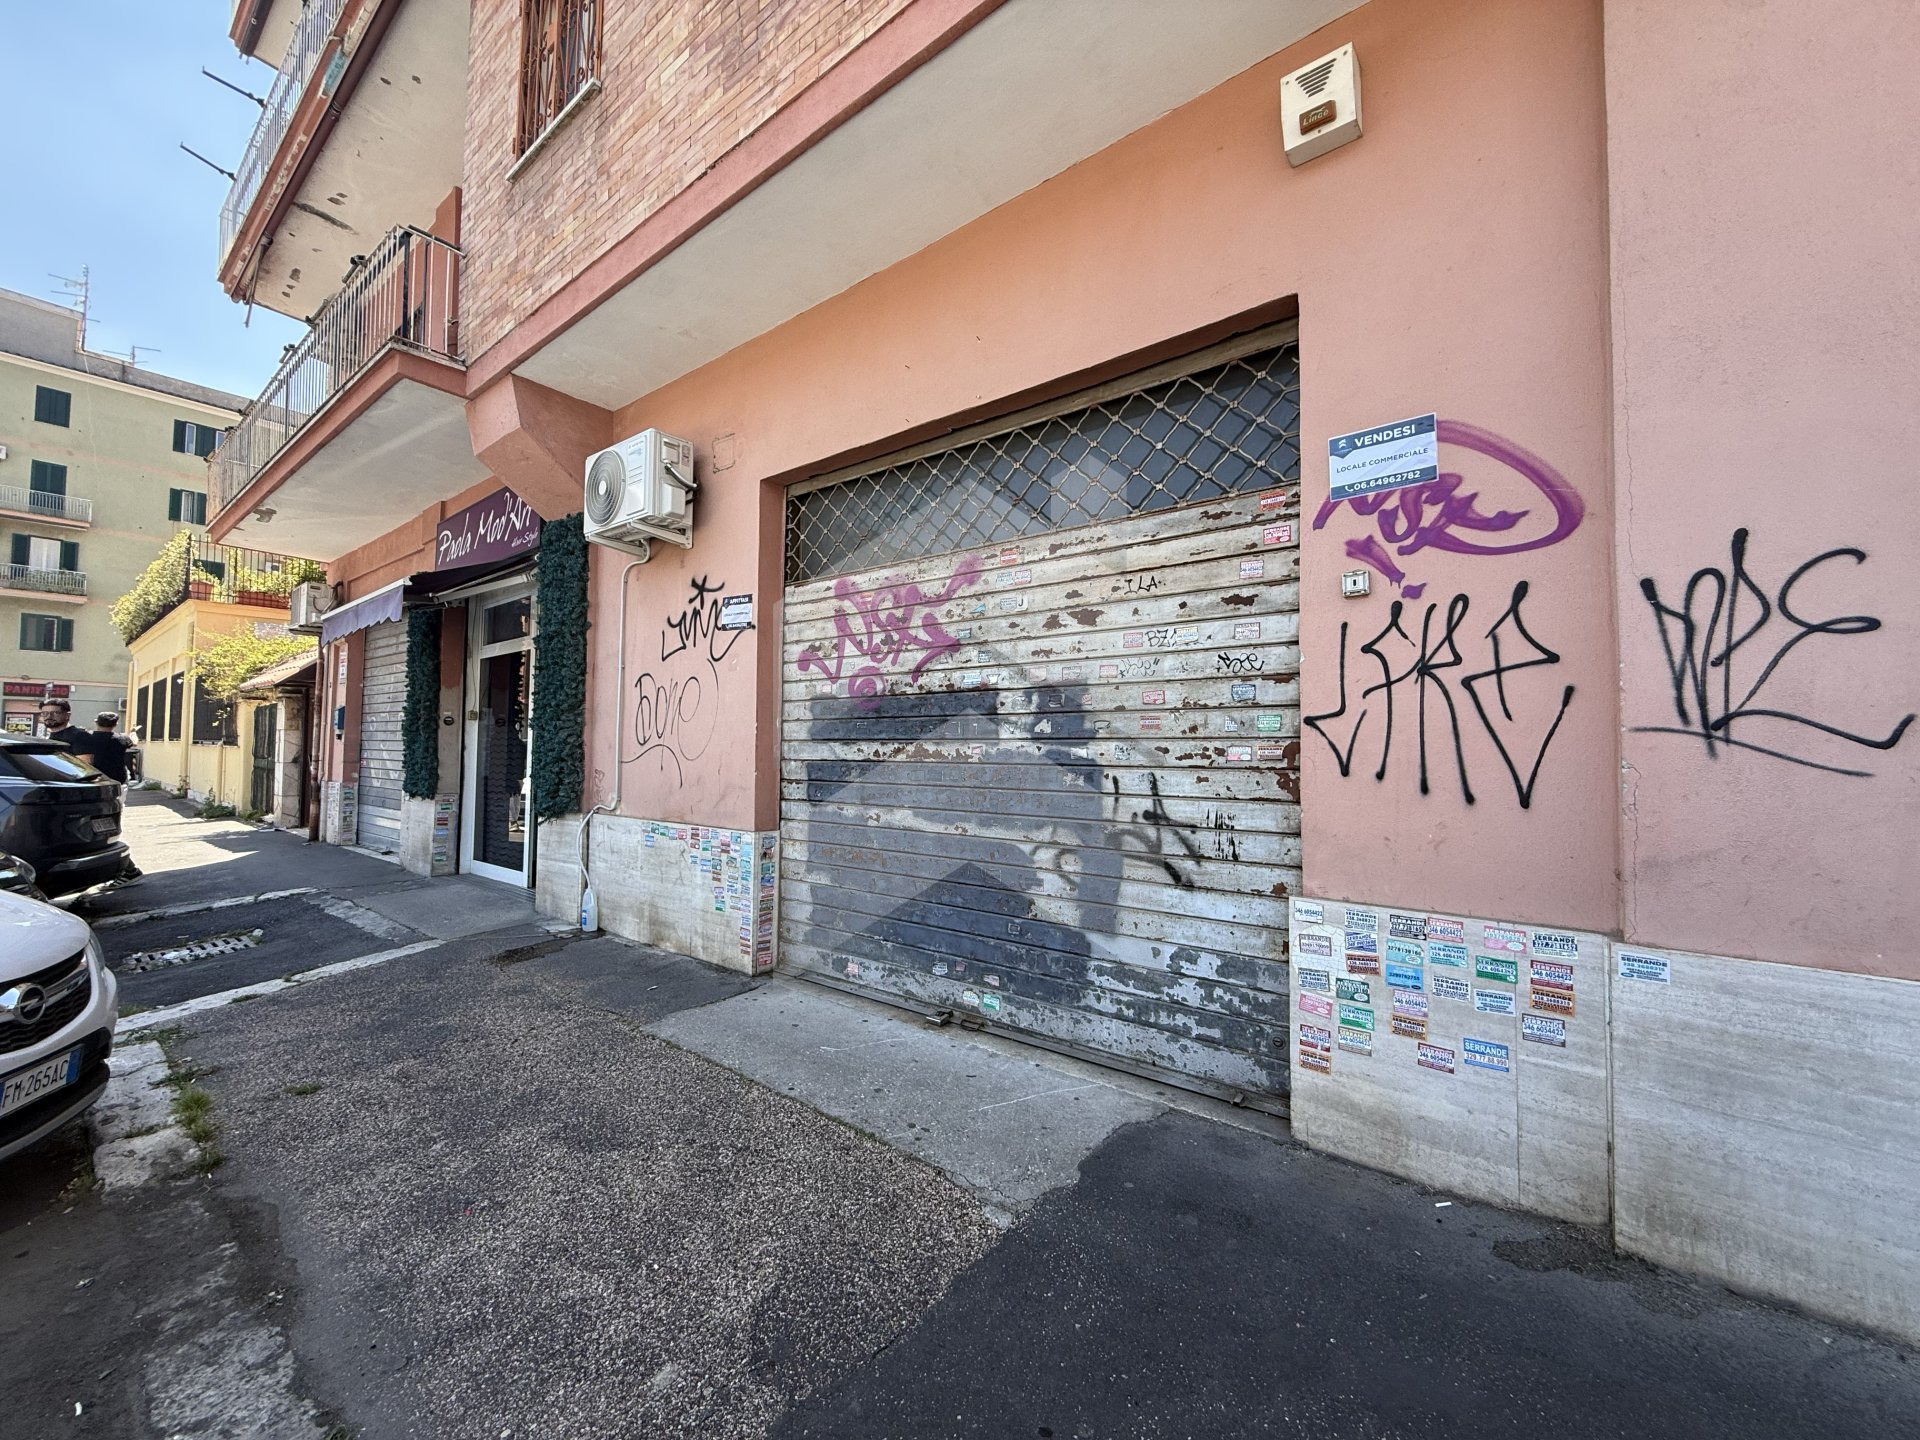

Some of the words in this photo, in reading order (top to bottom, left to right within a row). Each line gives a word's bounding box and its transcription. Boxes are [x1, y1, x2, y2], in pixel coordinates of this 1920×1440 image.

[1355, 424, 1416, 447] VENDESI
[1336, 462, 1367, 474] LOCALE
[1368, 448, 1429, 466] COMMERCIALE
[1354, 471, 1421, 490] 06.64962782
[438, 512, 472, 566] Paola
[1346, 911, 1377, 920] SERRANDE
[1391, 918, 1425, 926] SERRANDE
[1430, 920, 1462, 930] SERRANDE
[1485, 928, 1525, 937] SERRANDE
[1534, 935, 1576, 944] SERRANDE
[1430, 946, 1465, 955] SERRANDE
[1477, 960, 1516, 971] SERRANDE
[1621, 957, 1667, 967] SERRANDE
[1531, 969, 1543, 977] 346
[1533, 964, 1571, 974] SERRANDE
[1433, 977, 1469, 987] SERRANDE
[1475, 992, 1513, 1001] SERRANDE
[1532, 990, 1572, 1001] SERRANDE
[1392, 1017, 1425, 1027] SERRANDE
[1524, 1018, 1563, 1028] SERRANDE
[1523, 1023, 1535, 1032] 346
[1339, 1028, 1370, 1040] SERRANDE
[1464, 1042, 1507, 1057] SERRANDE
